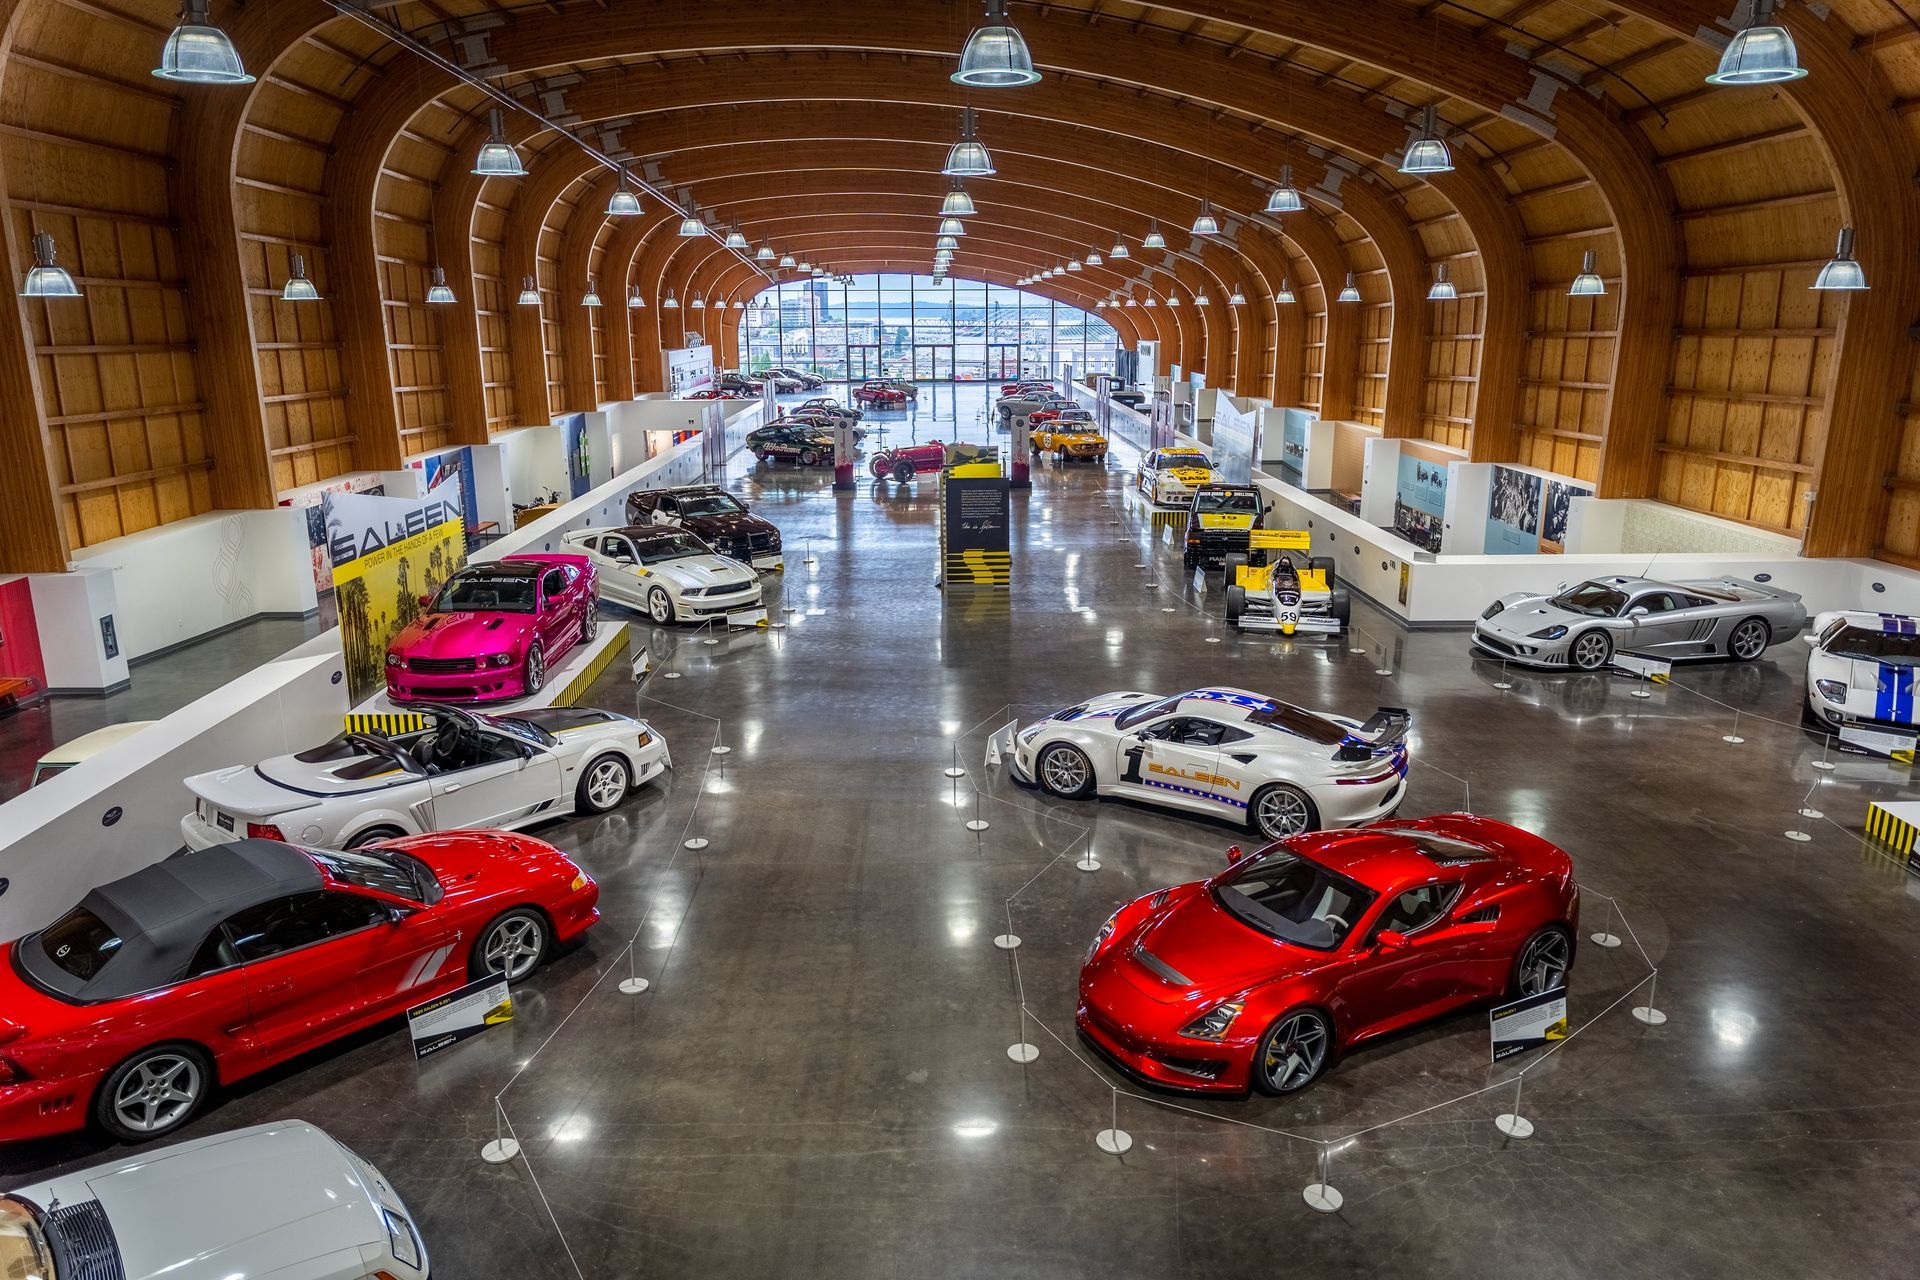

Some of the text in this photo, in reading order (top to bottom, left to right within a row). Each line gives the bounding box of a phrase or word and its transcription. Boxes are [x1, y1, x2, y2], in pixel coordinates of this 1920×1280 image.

[330, 495, 462, 569] SALEEN
[637, 532, 692, 543] SALEEN
[364, 552, 386, 569] POWER
[386, 550, 392, 562] IN
[393, 545, 403, 559] THE
[403, 538, 422, 554] HANDS
[422, 534, 429, 547] OF
[433, 529, 444, 541] FEW
[1120, 745, 1145, 785] 1
[1148, 762, 1240, 791] SALEEN
[420, 1036, 457, 1056] SALEEN
[1496, 1045, 1524, 1059] SALEEN
